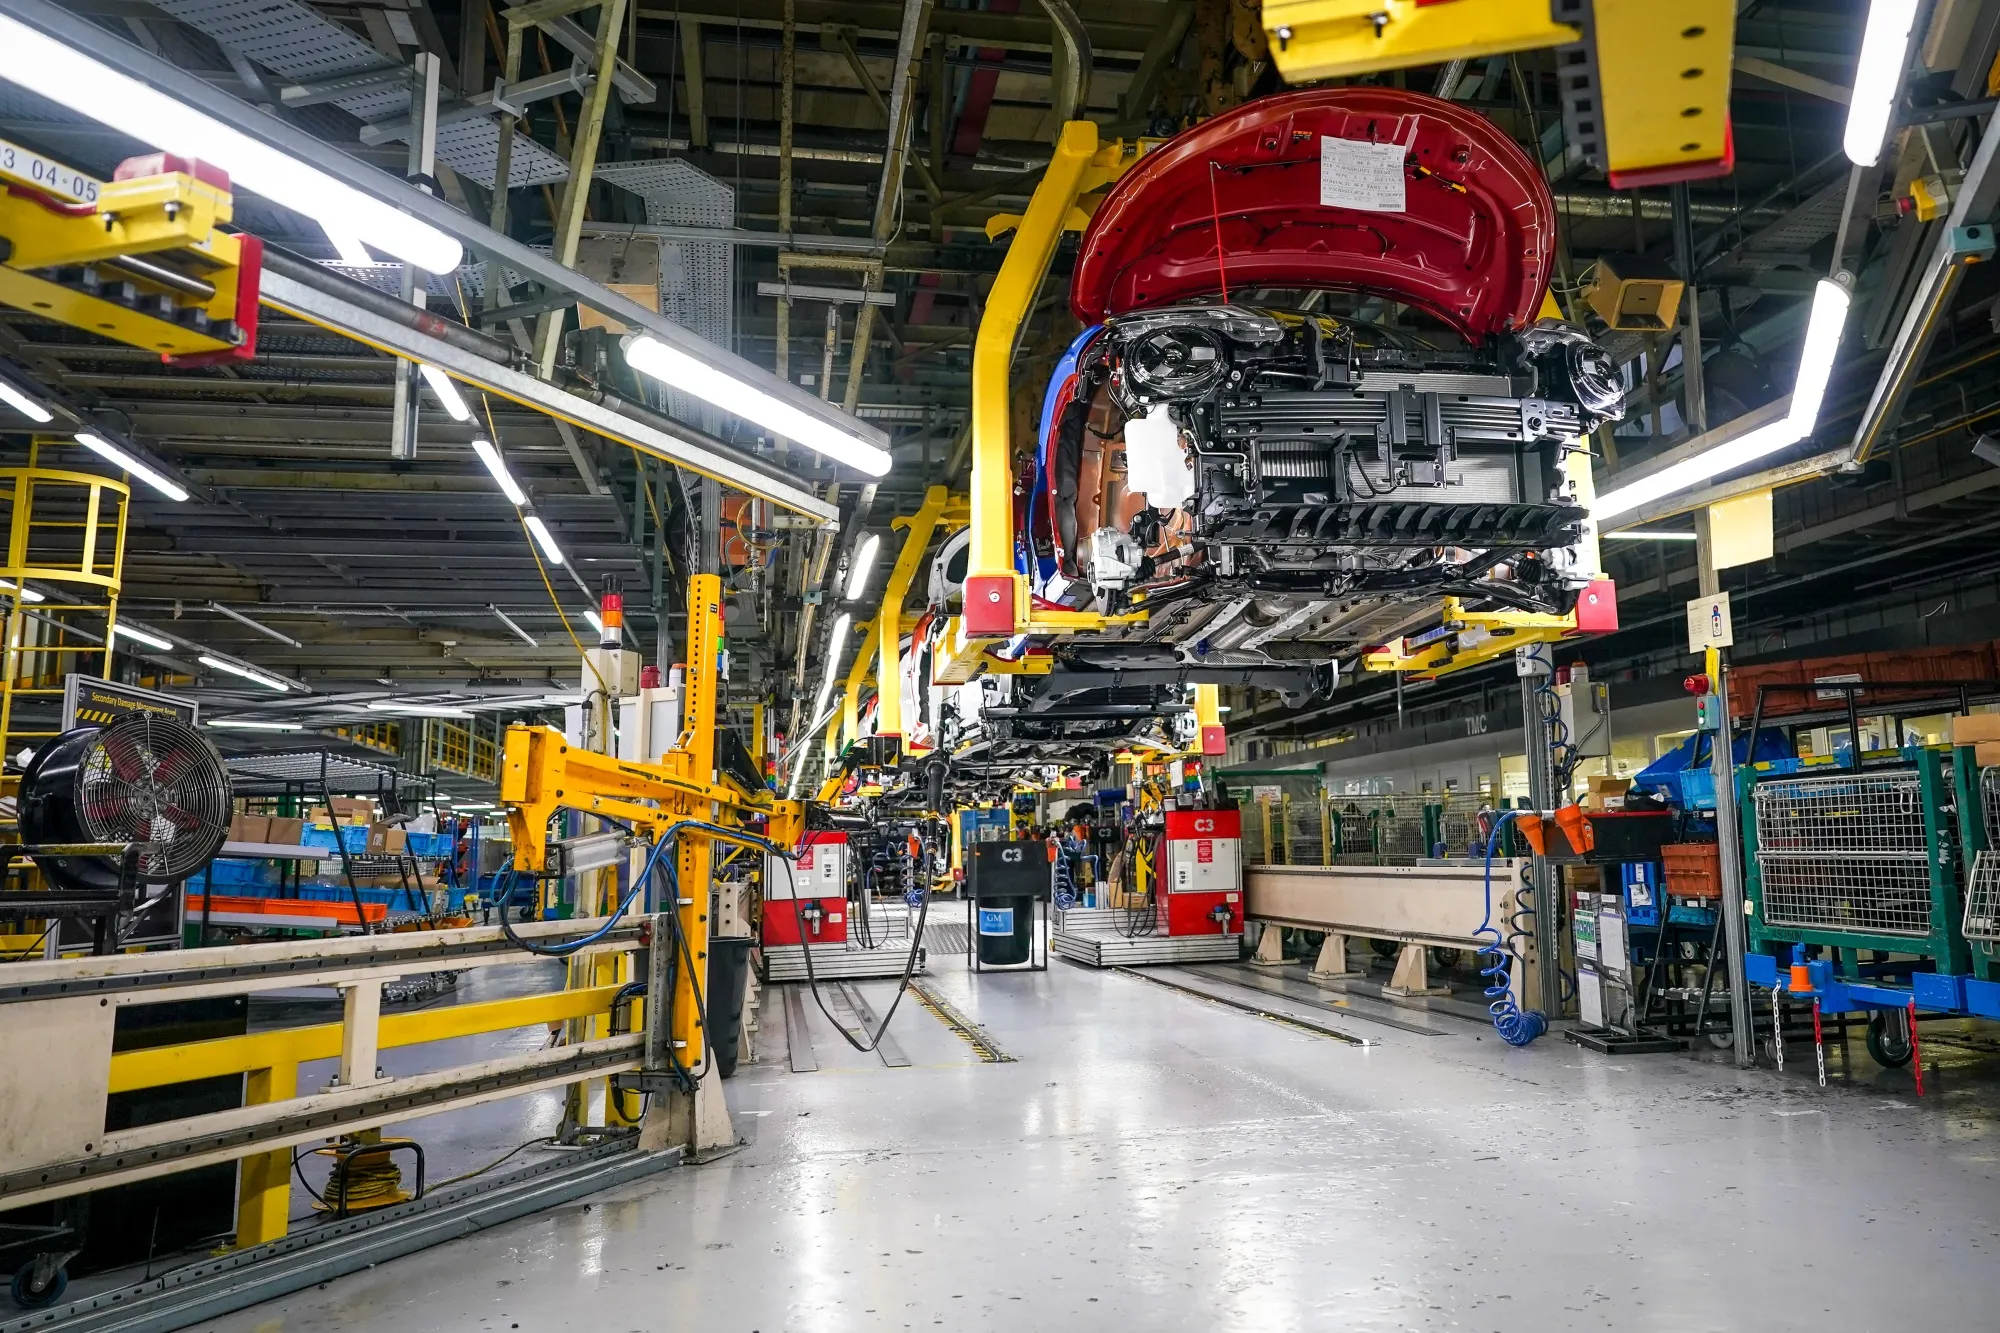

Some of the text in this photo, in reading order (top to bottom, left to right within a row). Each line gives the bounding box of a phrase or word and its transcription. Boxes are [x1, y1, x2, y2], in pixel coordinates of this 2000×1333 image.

[0, 147, 15, 169] 3
[91, 691, 117, 707] Secondary
[117, 697, 136, 711] Damage
[136, 701, 164, 713] Management
[1465, 714, 1487, 735] TMC
[1098, 828, 1112, 838] C3
[1194, 818, 1215, 832] C3
[1001, 847, 1023, 863] C3
[986, 913, 1002, 922] GM
